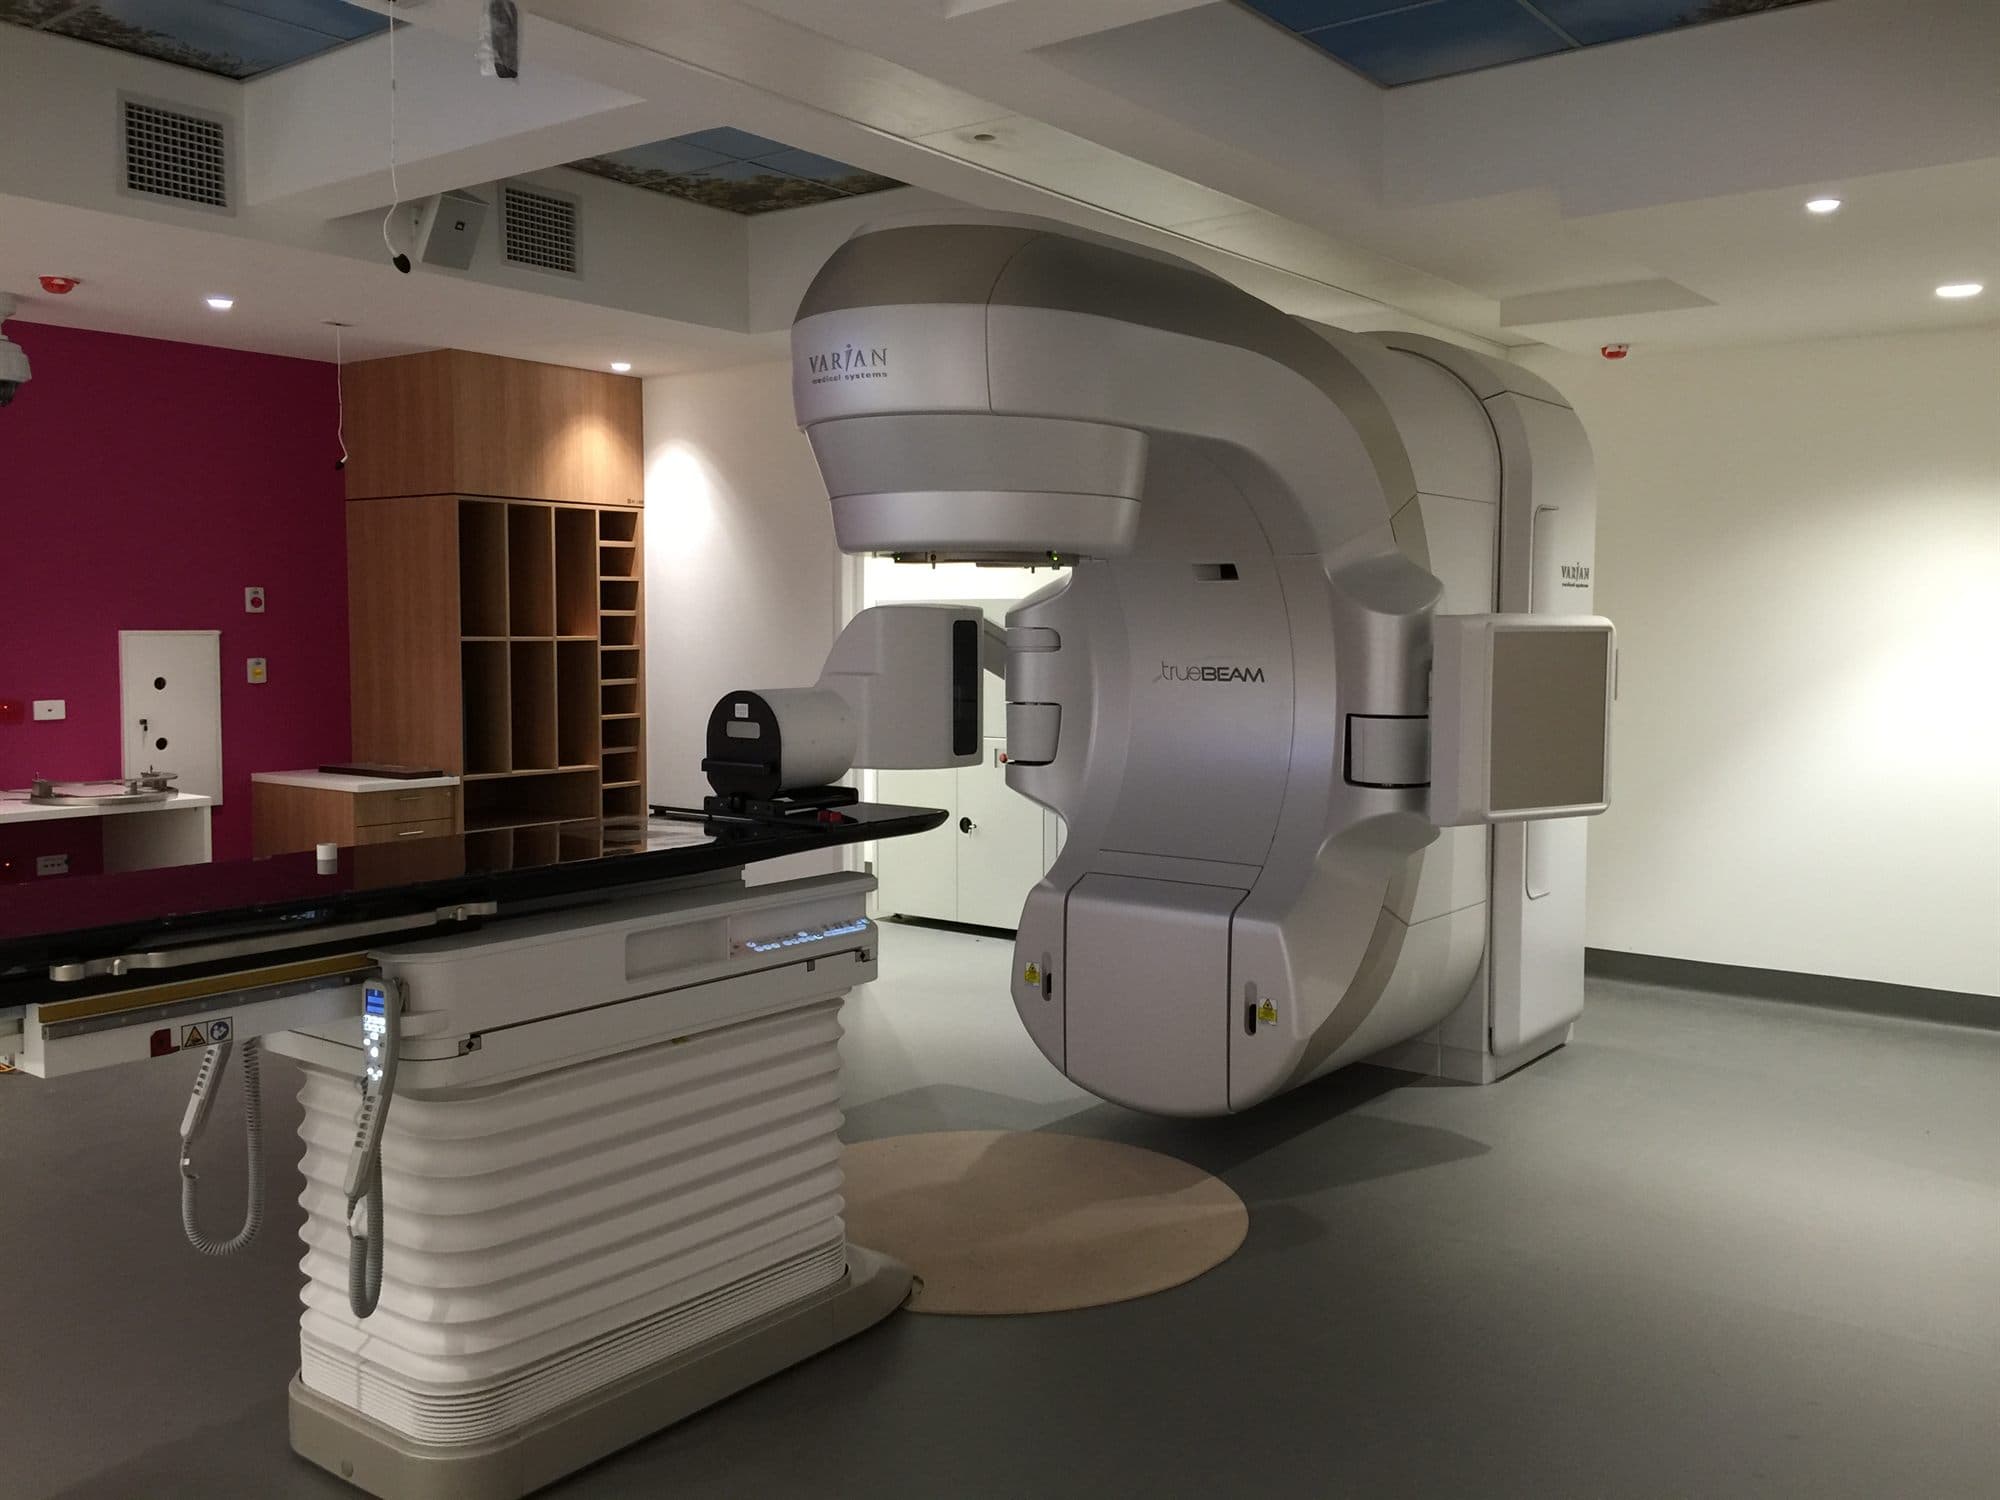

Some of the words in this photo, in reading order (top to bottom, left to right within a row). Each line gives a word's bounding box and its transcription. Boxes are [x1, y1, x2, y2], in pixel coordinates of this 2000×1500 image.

[809, 343, 888, 374] VARIAN
[844, 371, 888, 381] systems
[1560, 562, 1590, 581] VARIAN
[1161, 659, 1265, 683] trueBEAM
